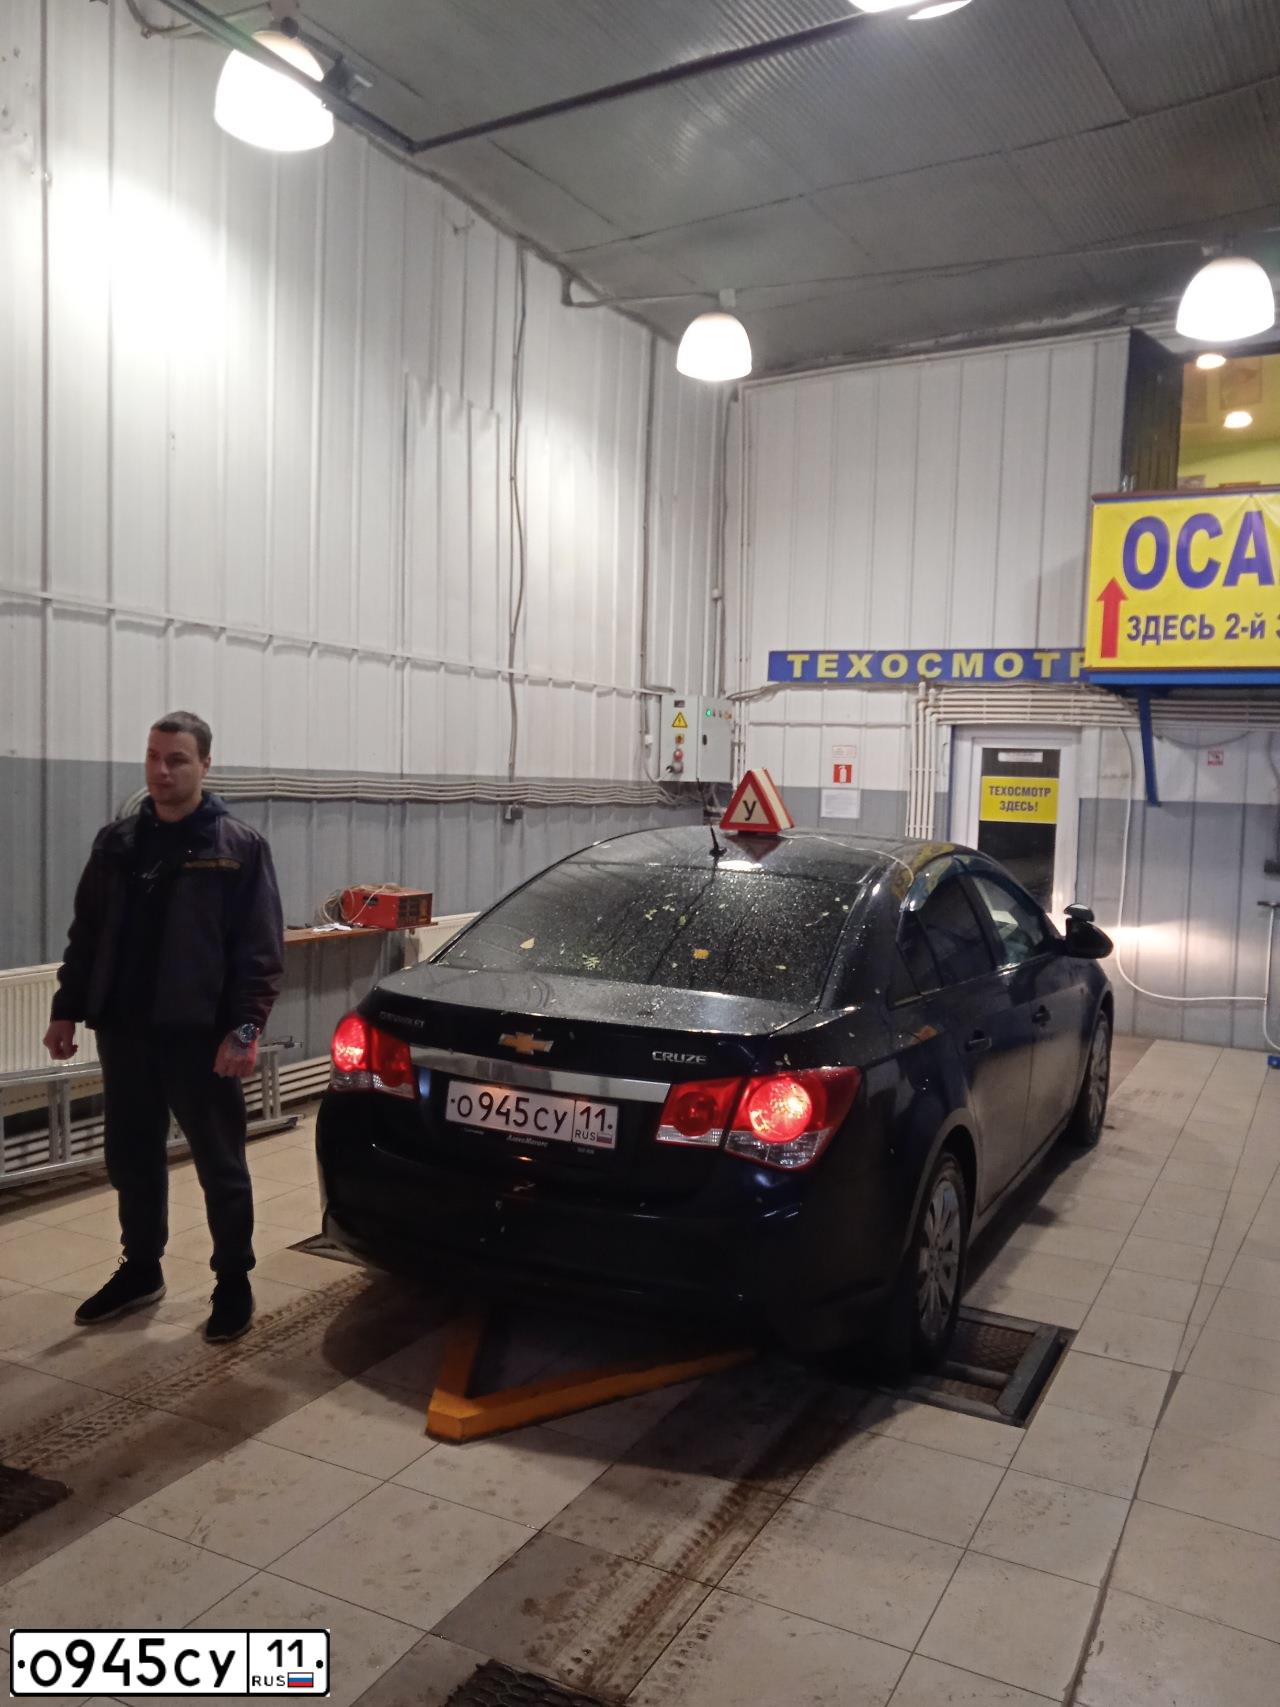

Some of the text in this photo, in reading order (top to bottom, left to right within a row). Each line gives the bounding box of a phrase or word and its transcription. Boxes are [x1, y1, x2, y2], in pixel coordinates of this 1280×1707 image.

[1122, 510, 1280, 591] ОСА
[1126, 613, 1216, 647] ЗДЕСЬ
[1224, 611, 1267, 641] 2-й
[988, 785, 1052, 798] ТЕХОСМОТР
[999, 800, 1039, 813] ЗДЕСЬ!
[651, 1050, 707, 1065] CRUZE
[579, 1105, 607, 1132] 11
[574, 1129, 597, 1142] RUS
